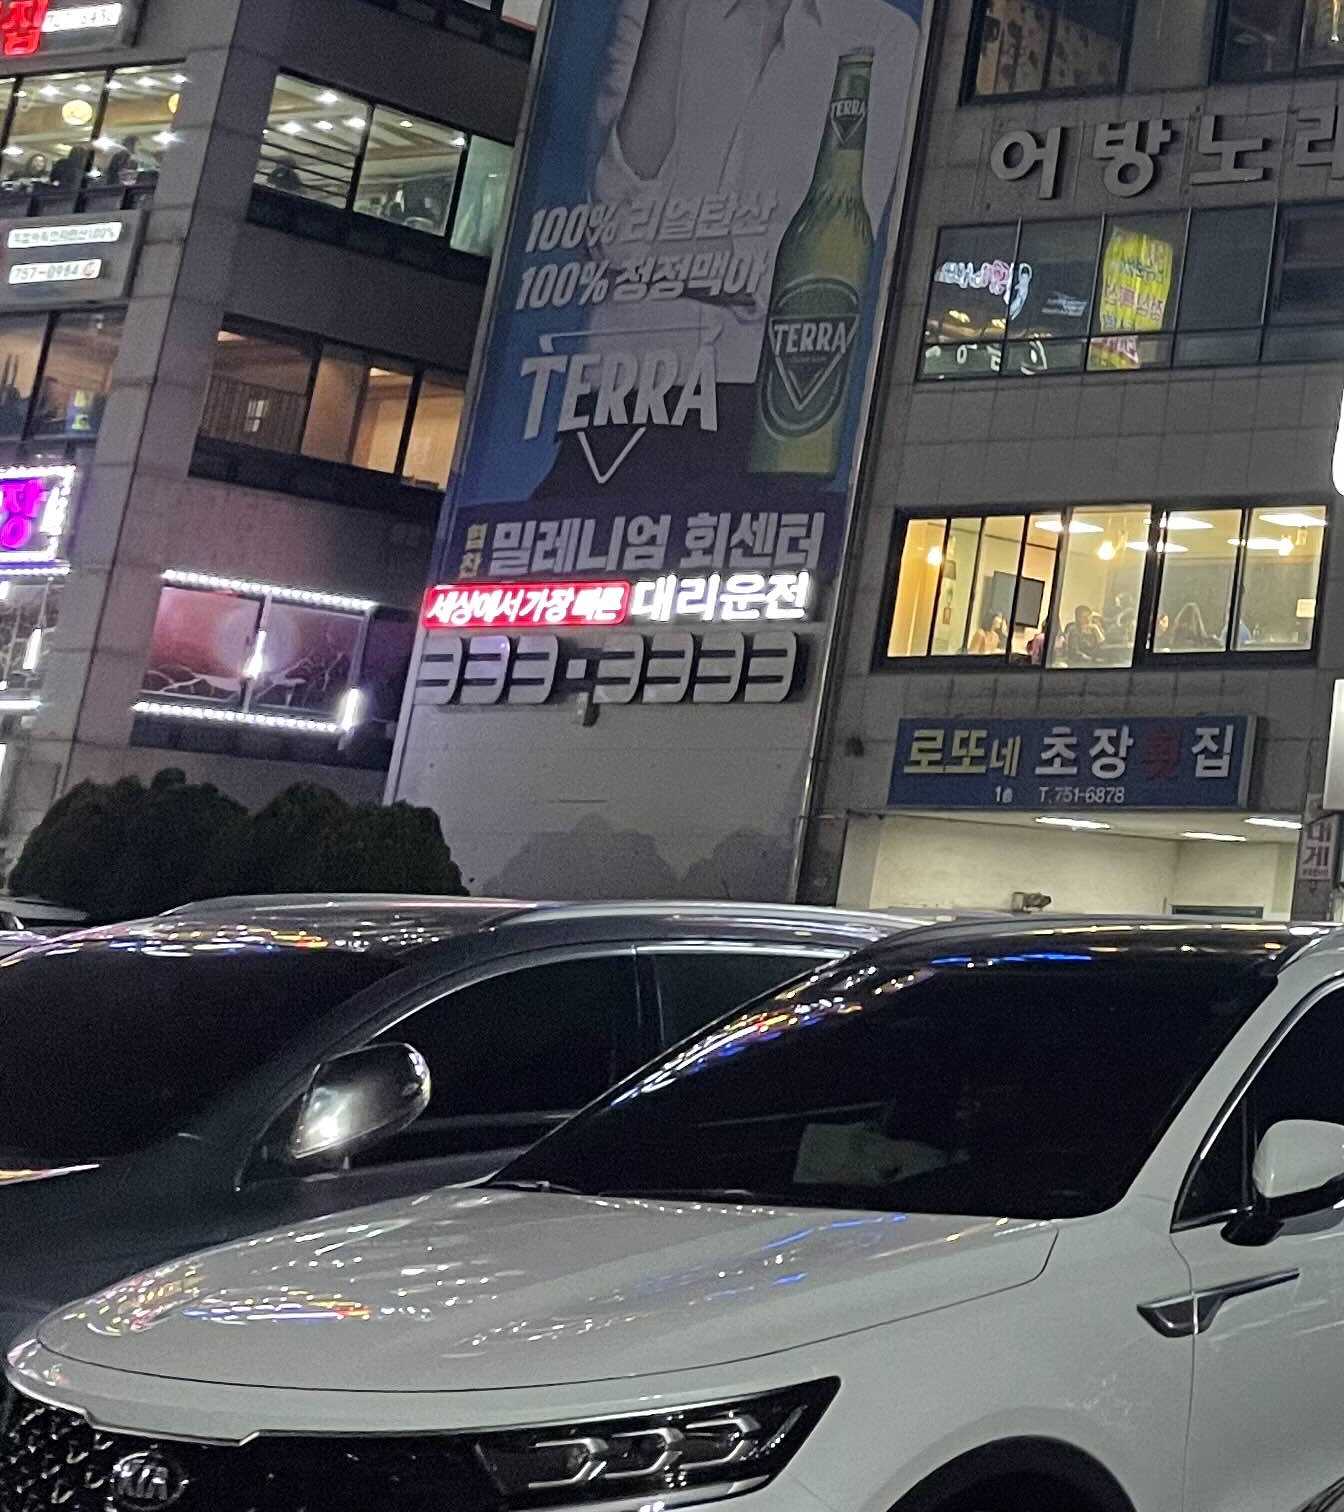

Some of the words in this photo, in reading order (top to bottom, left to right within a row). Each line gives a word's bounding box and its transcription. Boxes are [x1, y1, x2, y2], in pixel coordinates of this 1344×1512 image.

[525, 199, 620, 253] 100%
[515, 259, 609, 311] 100%
[774, 321, 848, 356] TERRA
[521, 344, 718, 440] TERRA
[489, 514, 672, 576] 밀레니엄
[679, 512, 825, 570] 회센터
[631, 571, 811, 622] 대리운전
[903, 727, 1022, 777] 로또네
